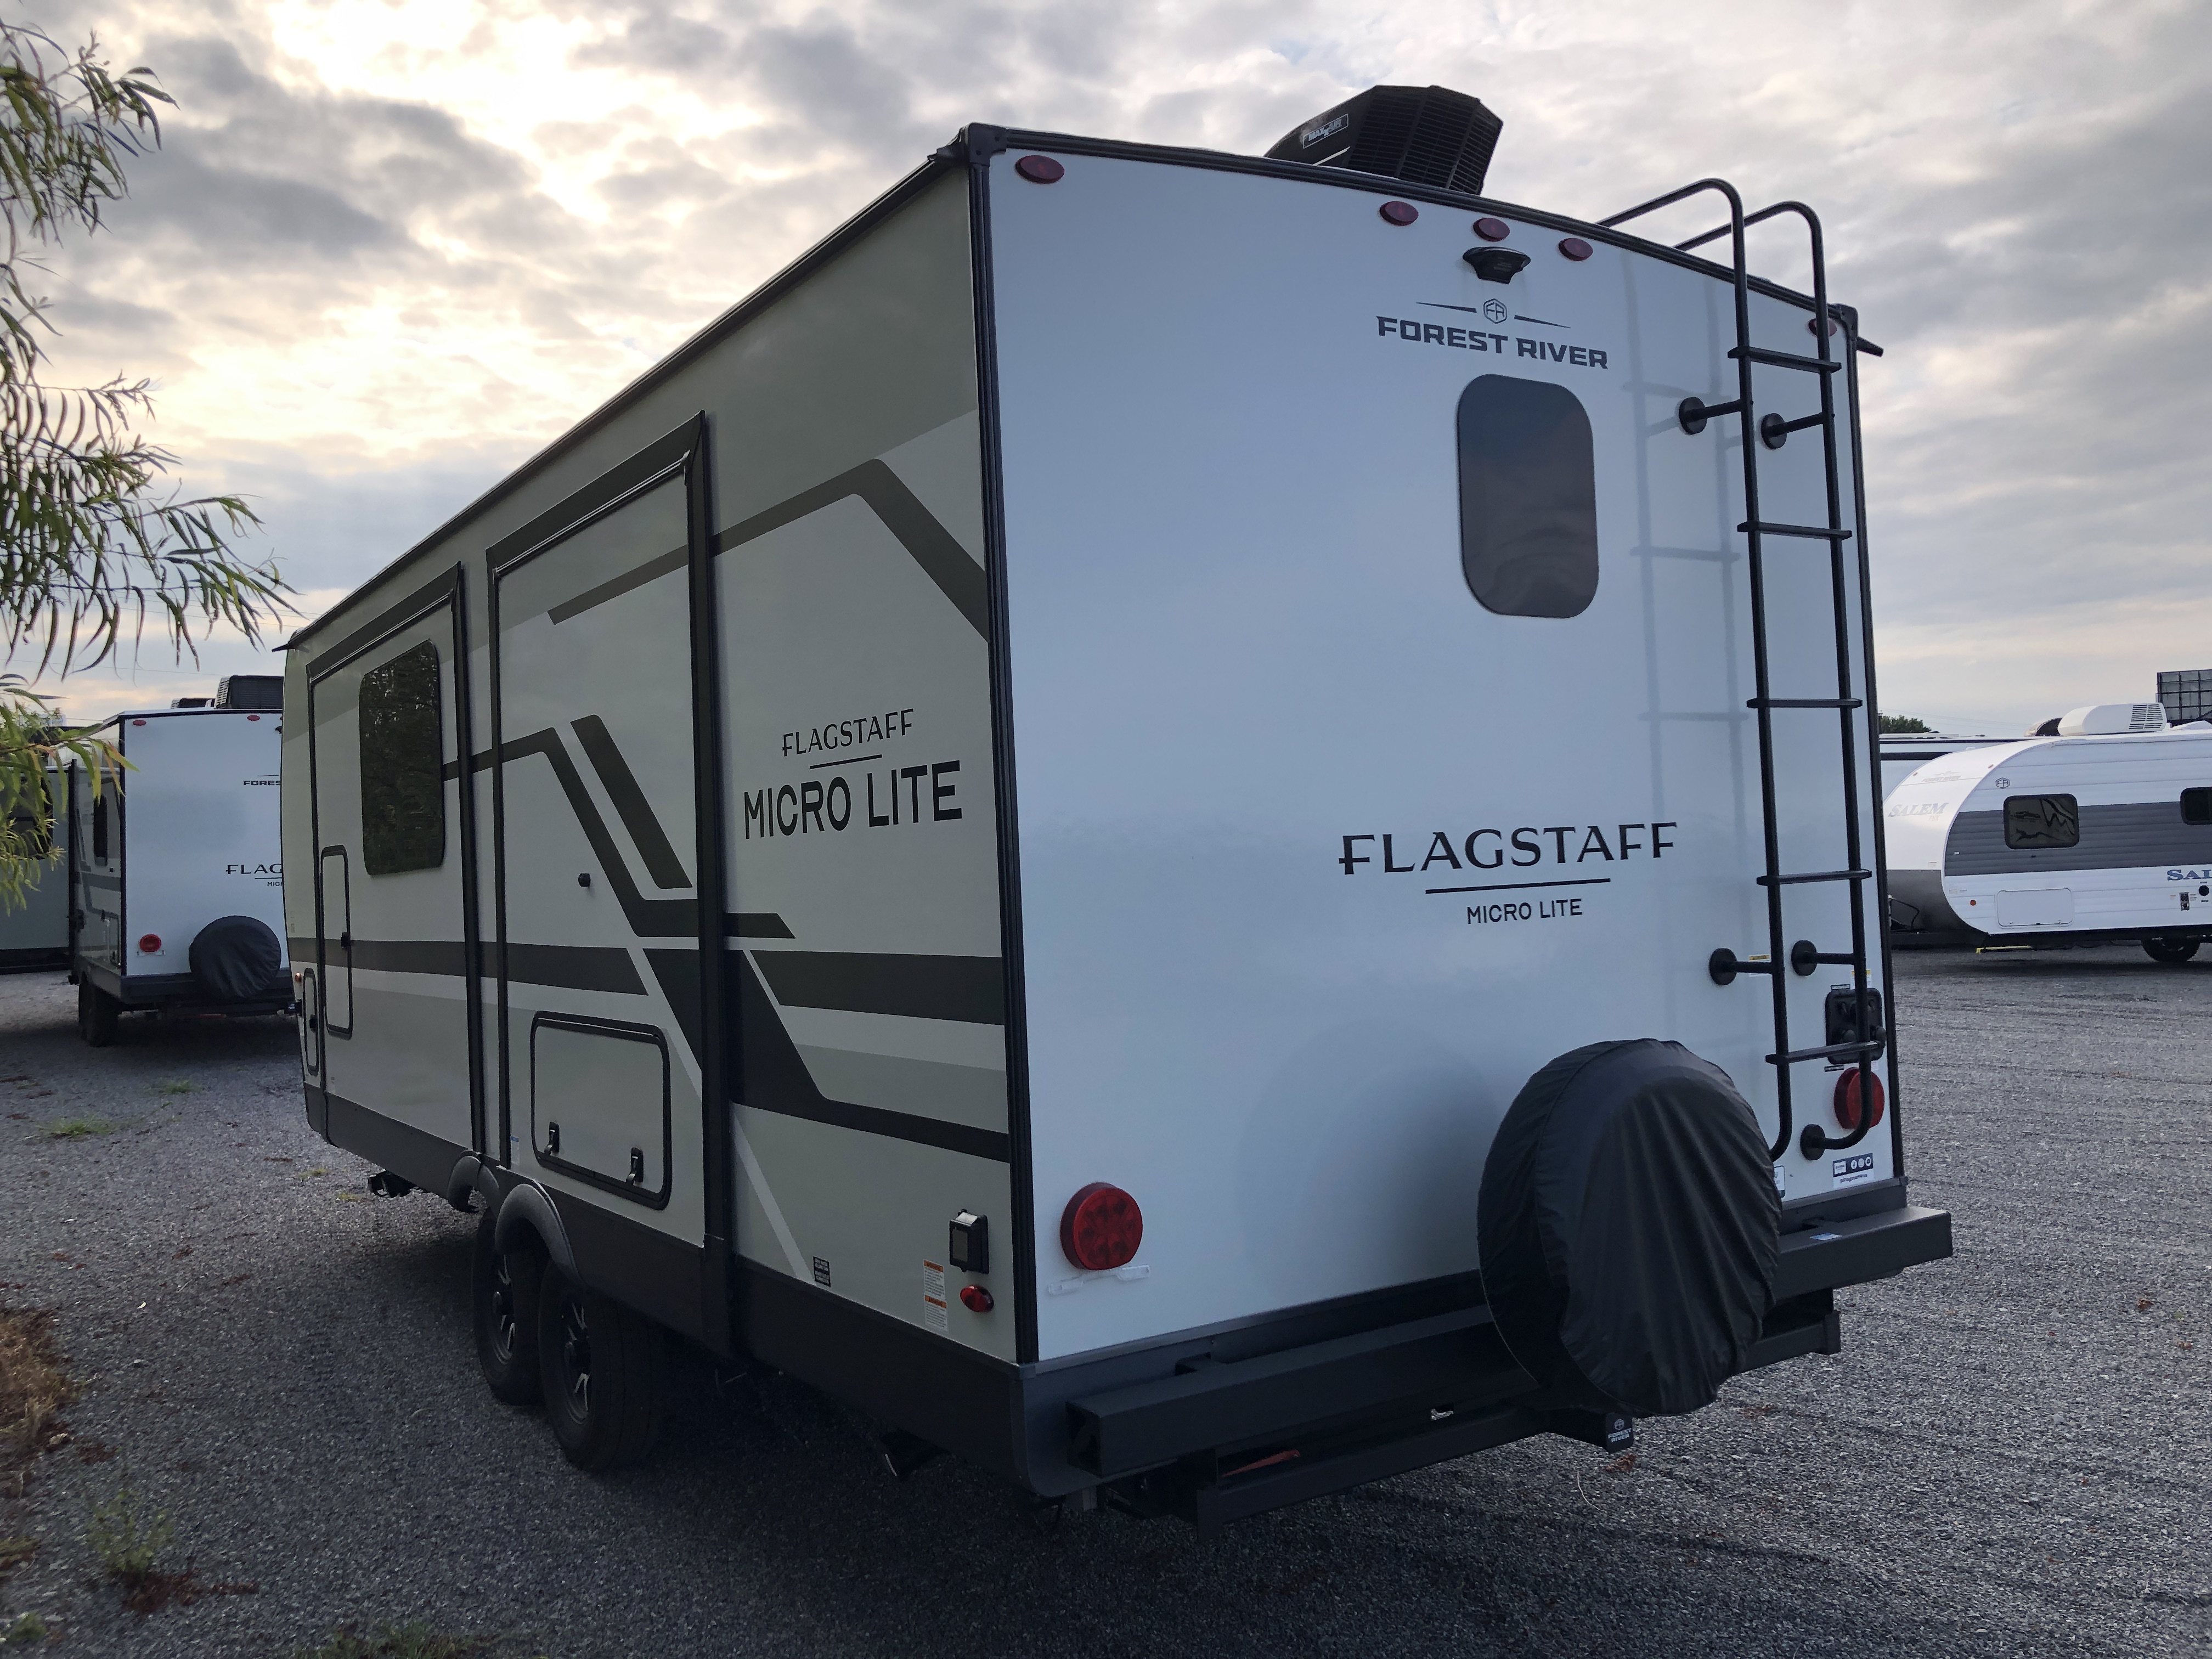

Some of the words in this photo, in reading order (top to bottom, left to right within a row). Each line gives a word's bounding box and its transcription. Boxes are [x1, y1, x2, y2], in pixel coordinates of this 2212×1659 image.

[1376, 315, 1508, 354] FOREST
[1515, 337, 1609, 370] RIVER
[782, 708, 914, 757] FLAGSTAFF
[744, 776, 851, 839] MICRO
[867, 760, 962, 827] LITE
[1888, 803, 1949, 817] SALEM
[1339, 822, 1677, 875] FLAGSTAFF
[1467, 902, 1532, 924] MICRO
[1539, 898, 1583, 919] LITE
[1608, 1427, 1632, 1439] FOREST
[1611, 1434, 1629, 1443] RIVER
